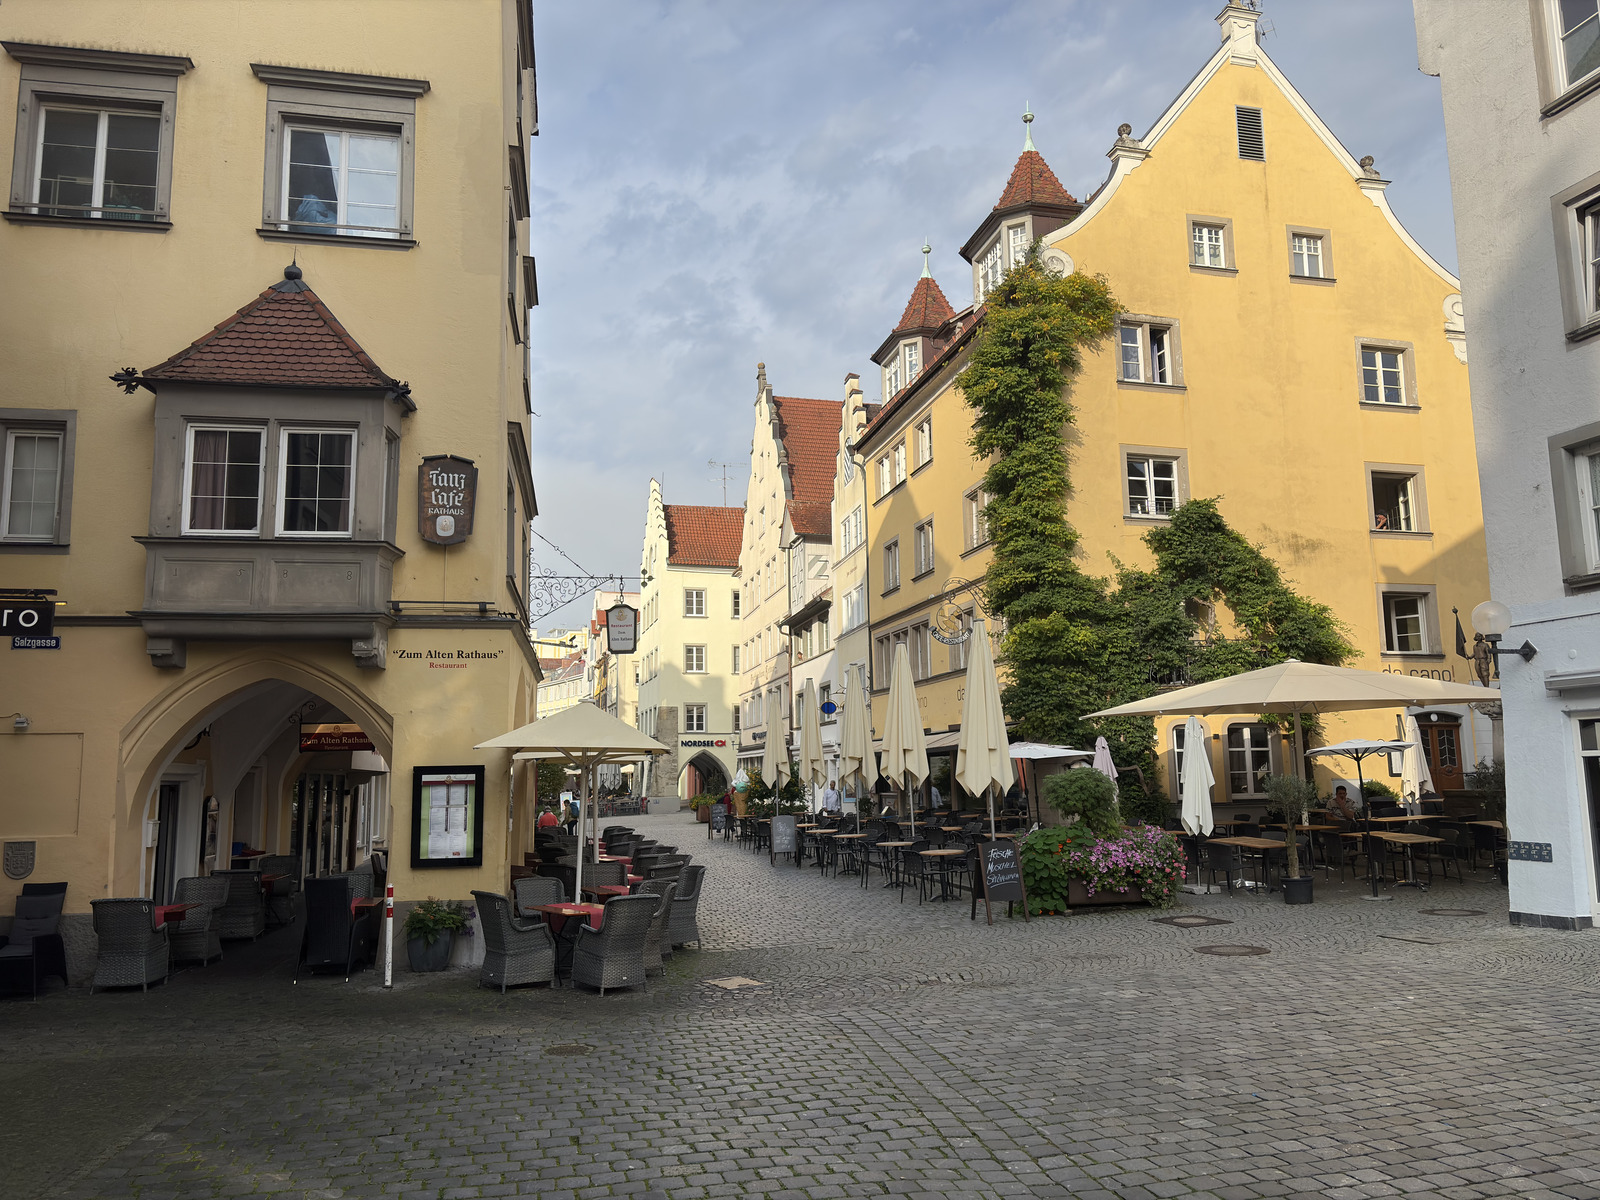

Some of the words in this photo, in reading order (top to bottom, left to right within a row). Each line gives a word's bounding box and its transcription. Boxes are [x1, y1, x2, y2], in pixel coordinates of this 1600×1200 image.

[429, 467, 466, 490] Tanz
[428, 507, 465, 516] RATHAUS
[14, 637, 56, 648] Salzgasse
[425, 649, 454, 659] Alten
[301, 737, 318, 745] Zum
